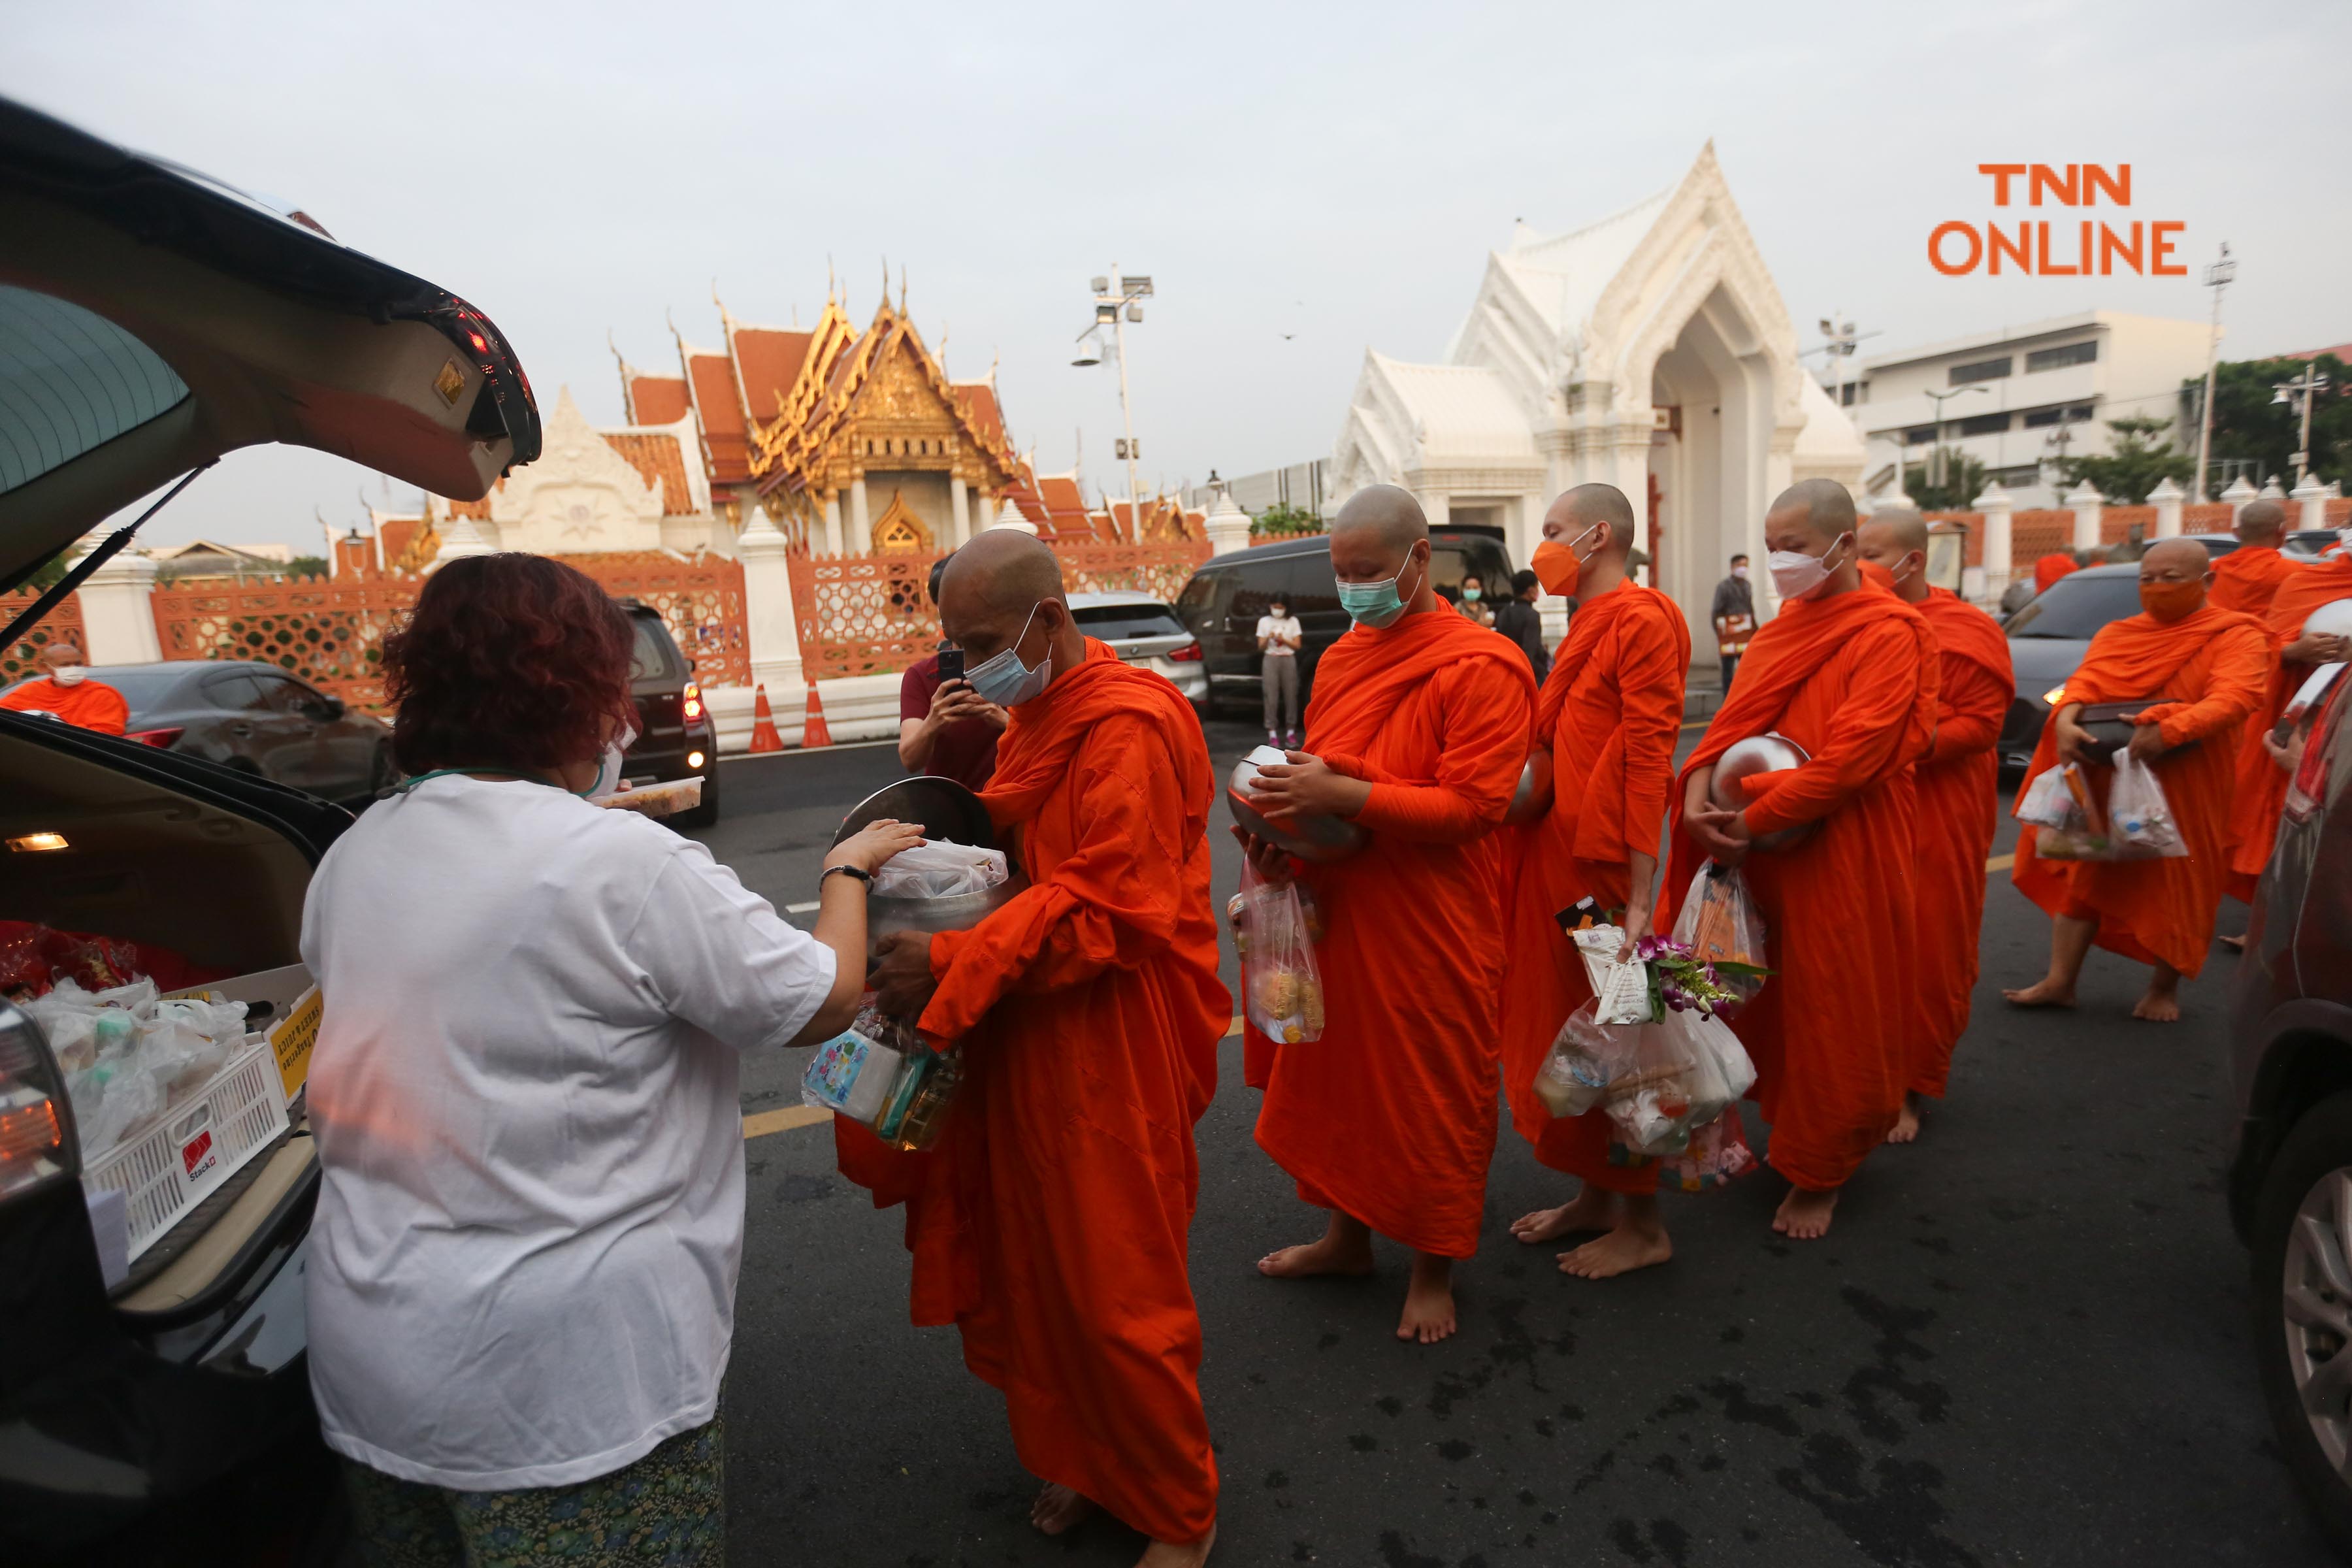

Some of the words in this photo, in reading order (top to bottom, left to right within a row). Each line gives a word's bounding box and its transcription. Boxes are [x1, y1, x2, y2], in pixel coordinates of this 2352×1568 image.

[302, 1005, 320, 1032] SWEET
[278, 1030, 297, 1056] JUICY
[282, 1036, 312, 1071] Tangerine
